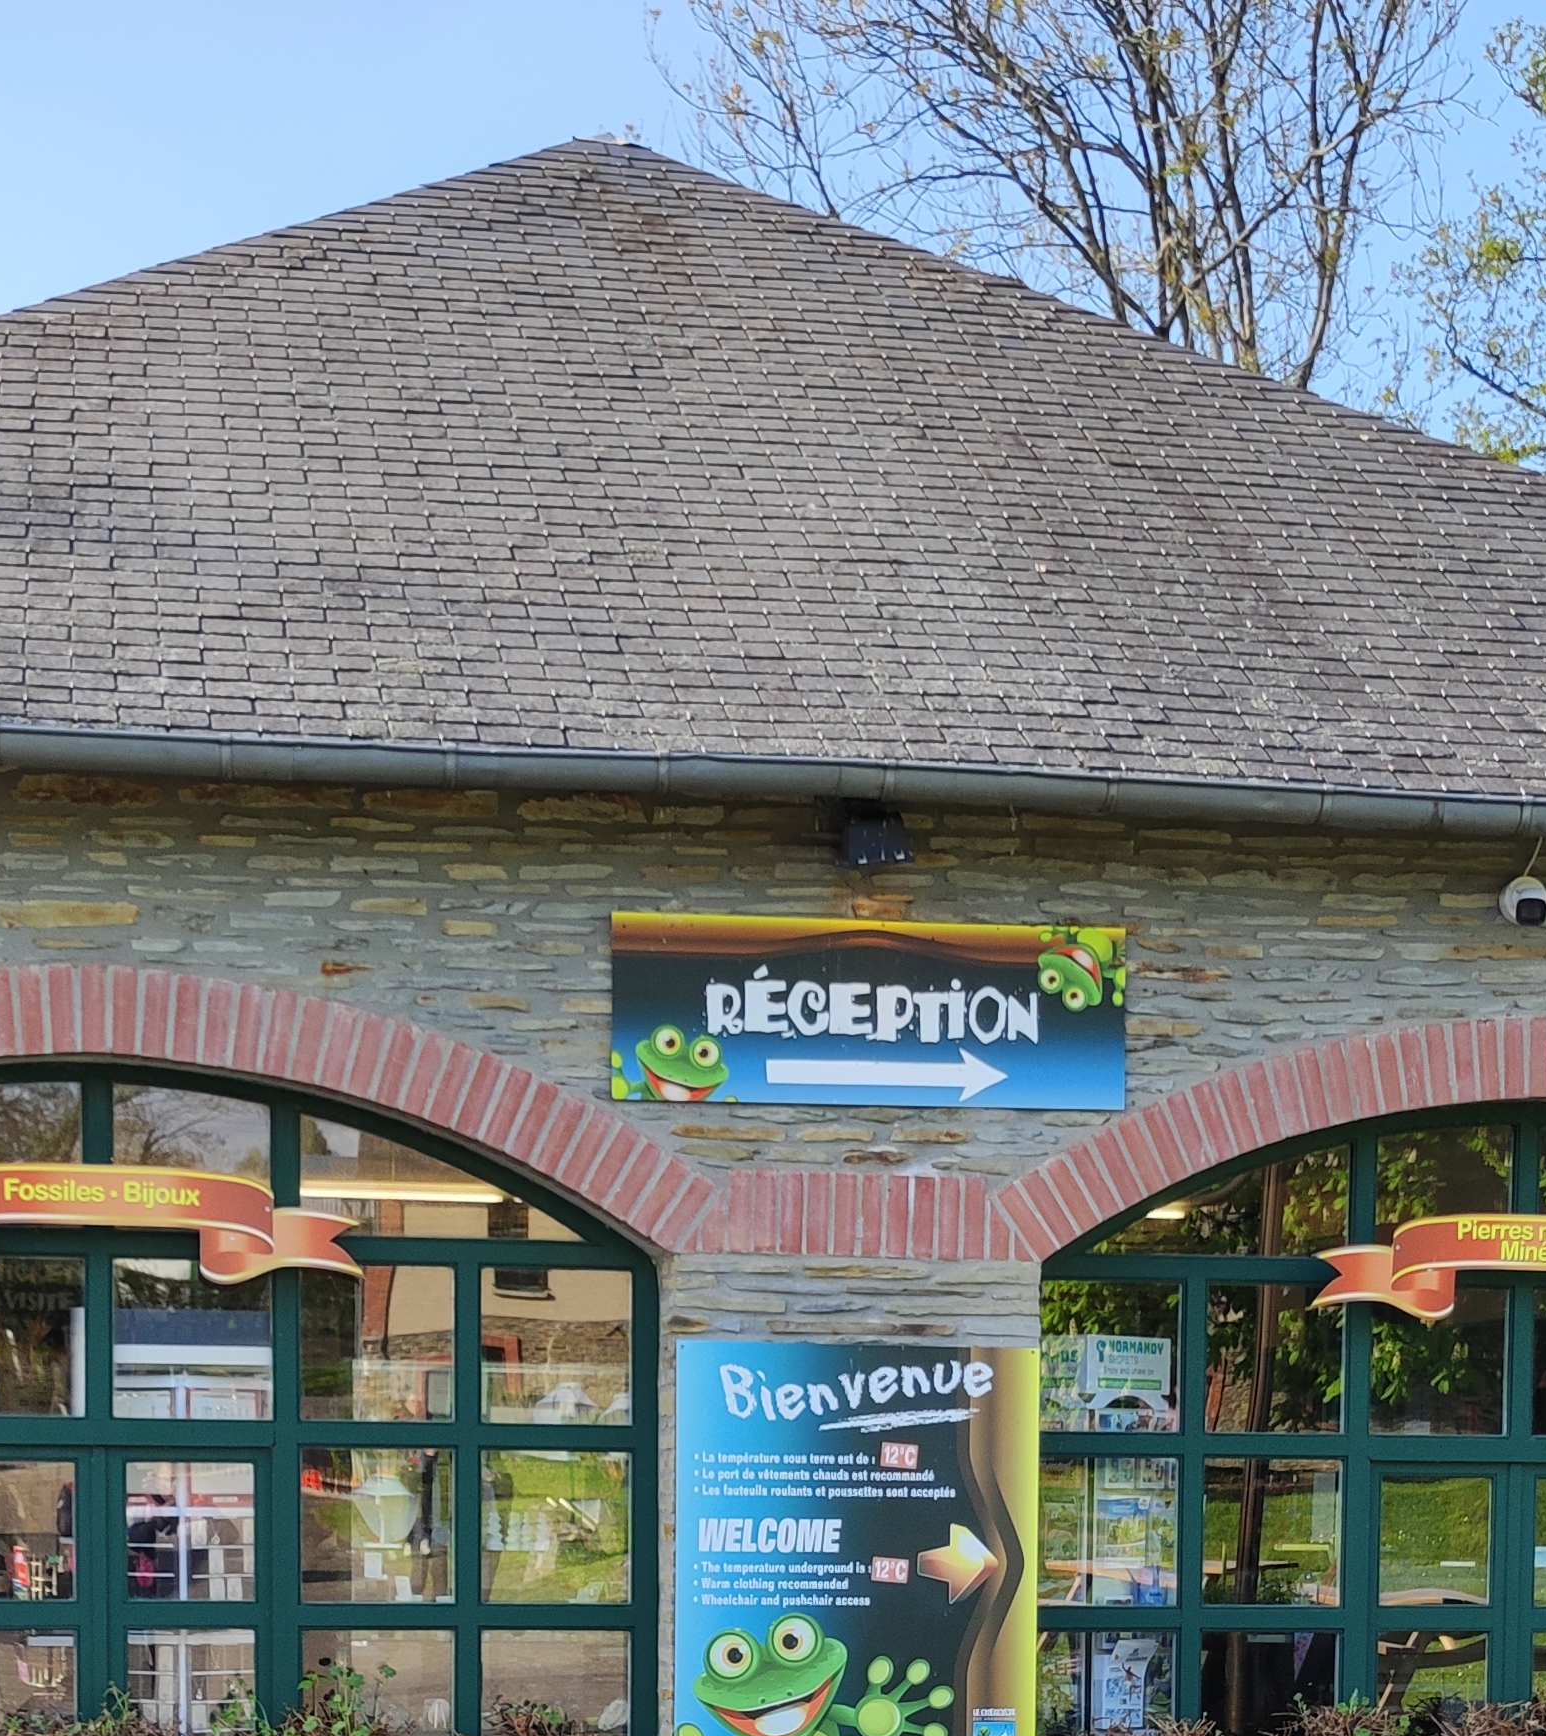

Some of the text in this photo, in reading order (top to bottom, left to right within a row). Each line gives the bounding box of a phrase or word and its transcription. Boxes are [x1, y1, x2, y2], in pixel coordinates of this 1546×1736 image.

[704, 964, 1040, 1045] RÉCEPTION
[3, 1177, 200, 1207] Fossiles Bijoux
[1457, 1219, 1534, 1241] Pierres
[1108, 1339, 1164, 1355] NORMANDY
[719, 1359, 994, 1421] Bienvenue
[702, 1451, 869, 1466] La température sous terre est de
[883, 1445, 917, 1466] 12°C
[702, 1467, 935, 1482] Le port de vêtements chauds est recommandé
[702, 1483, 956, 1501] Les fauteuils roulants et poussettes sont acceptés
[698, 1517, 842, 1553] WELCOME
[701, 1561, 865, 1576] The temperature underground is
[874, 1560, 907, 1580] 12°C
[701, 1577, 849, 1592] Warm clothing recommended
[701, 1594, 871, 1608] Wheelchair and pushchair access
